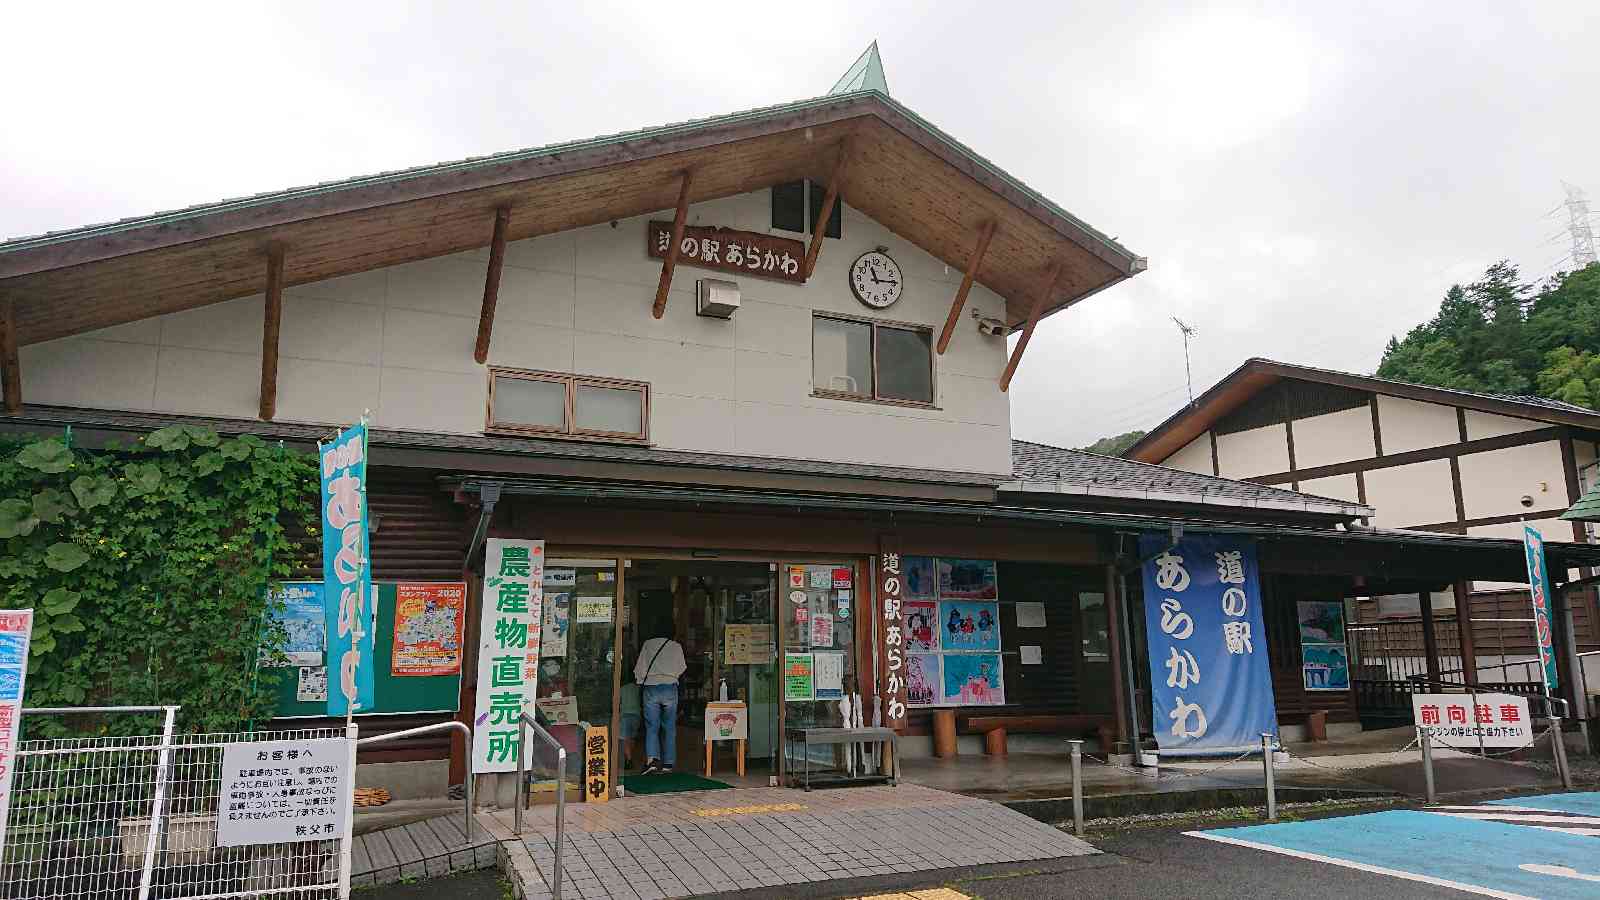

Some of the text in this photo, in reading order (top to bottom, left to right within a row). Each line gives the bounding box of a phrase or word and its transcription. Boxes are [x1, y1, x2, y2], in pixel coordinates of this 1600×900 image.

[1214, 550, 1253, 655] 道の駅
[487, 545, 531, 762] 農産物直売所
[1156, 551, 1208, 737] あらかわ
[1420, 703, 1521, 724] 前向駐車
[1421, 727, 1523, 737] ンジンの停止にご協力下さい
[256, 749, 313, 761] お客様へ
[588, 735, 606, 798] 営業中
[295, 823, 335, 836] 秩父市
